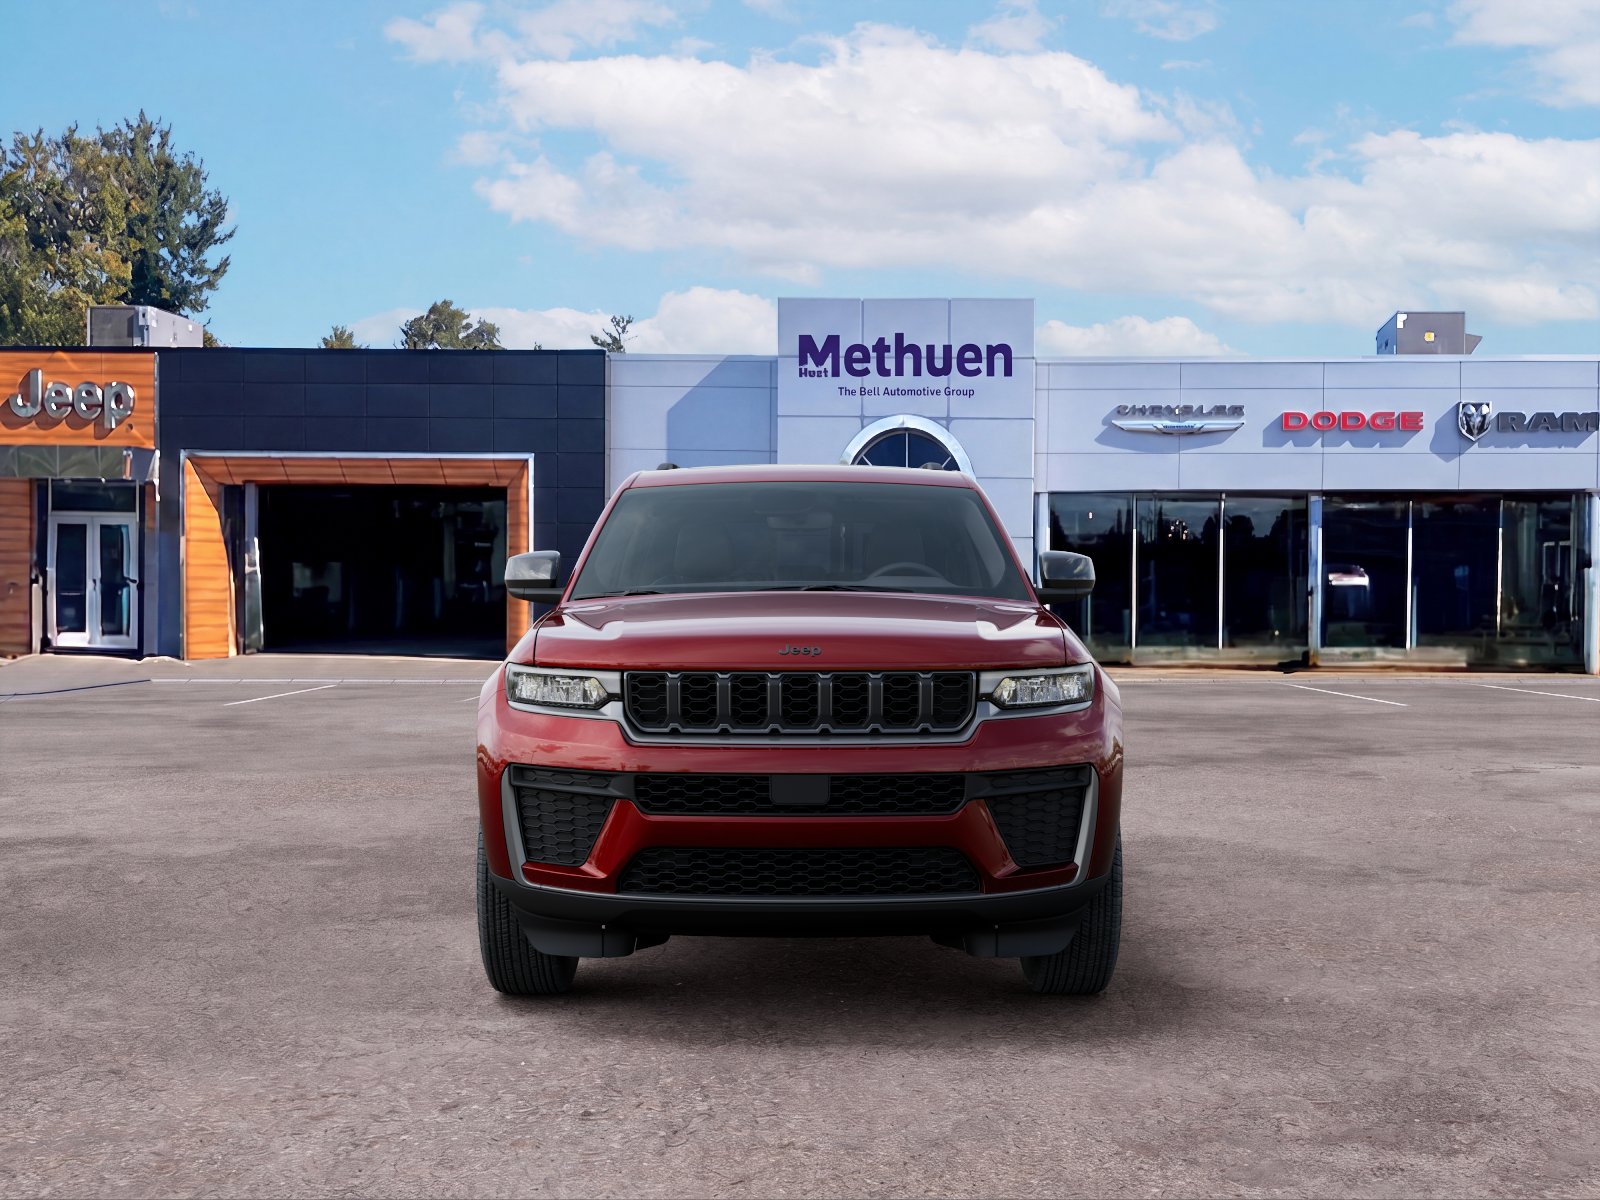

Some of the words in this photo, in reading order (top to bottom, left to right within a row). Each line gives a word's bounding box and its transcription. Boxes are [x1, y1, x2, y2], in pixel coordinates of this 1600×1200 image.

[798, 332, 1013, 378] Methuen
[9, 368, 135, 429] Jeep
[837, 386, 857, 396] The
[859, 386, 880, 396] Bell
[882, 386, 941, 396] Automotive
[943, 386, 975, 398] Group
[1281, 411, 1424, 431] DODGE
[1498, 411, 1599, 432] RAM
[778, 643, 822, 657] Jeep
